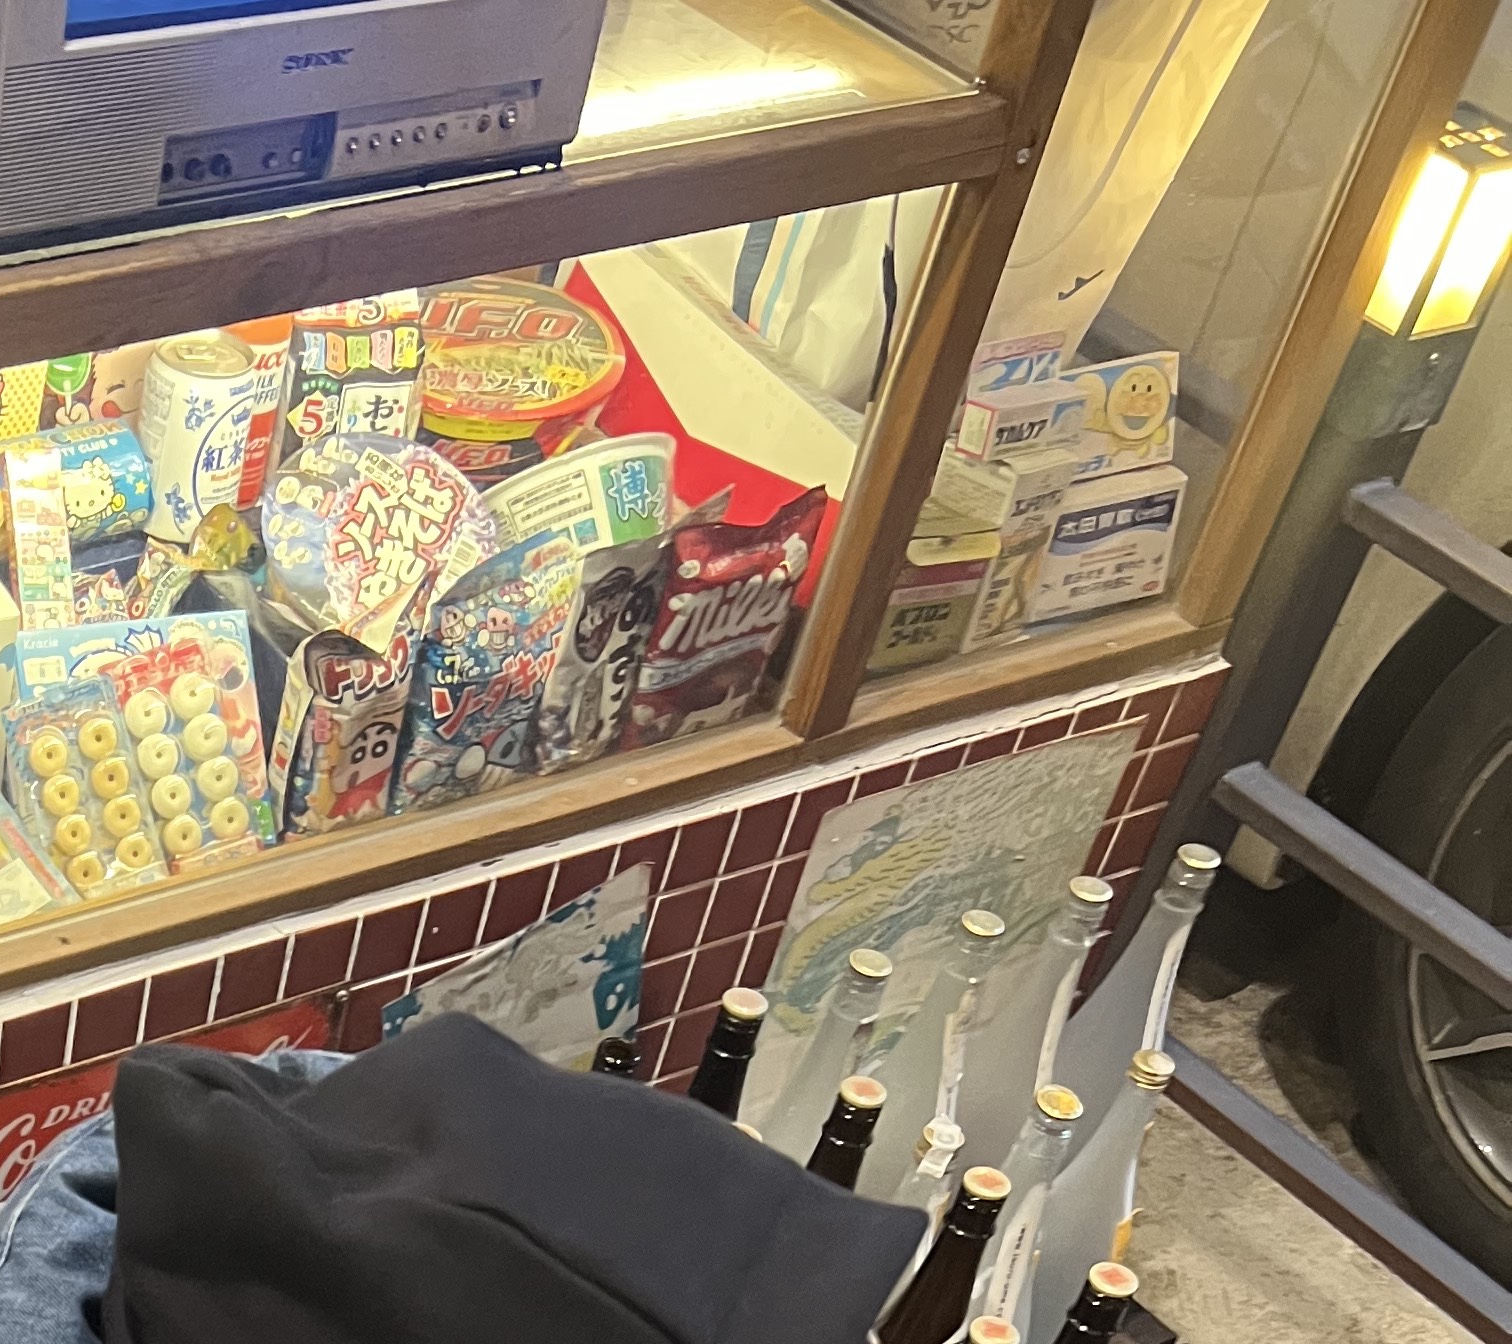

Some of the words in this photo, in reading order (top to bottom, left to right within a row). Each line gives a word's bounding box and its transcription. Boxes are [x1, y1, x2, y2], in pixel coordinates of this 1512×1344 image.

[280, 48, 354, 74] SONY
[298, 398, 324, 435] 5
[39, 1089, 113, 1132] DRI
